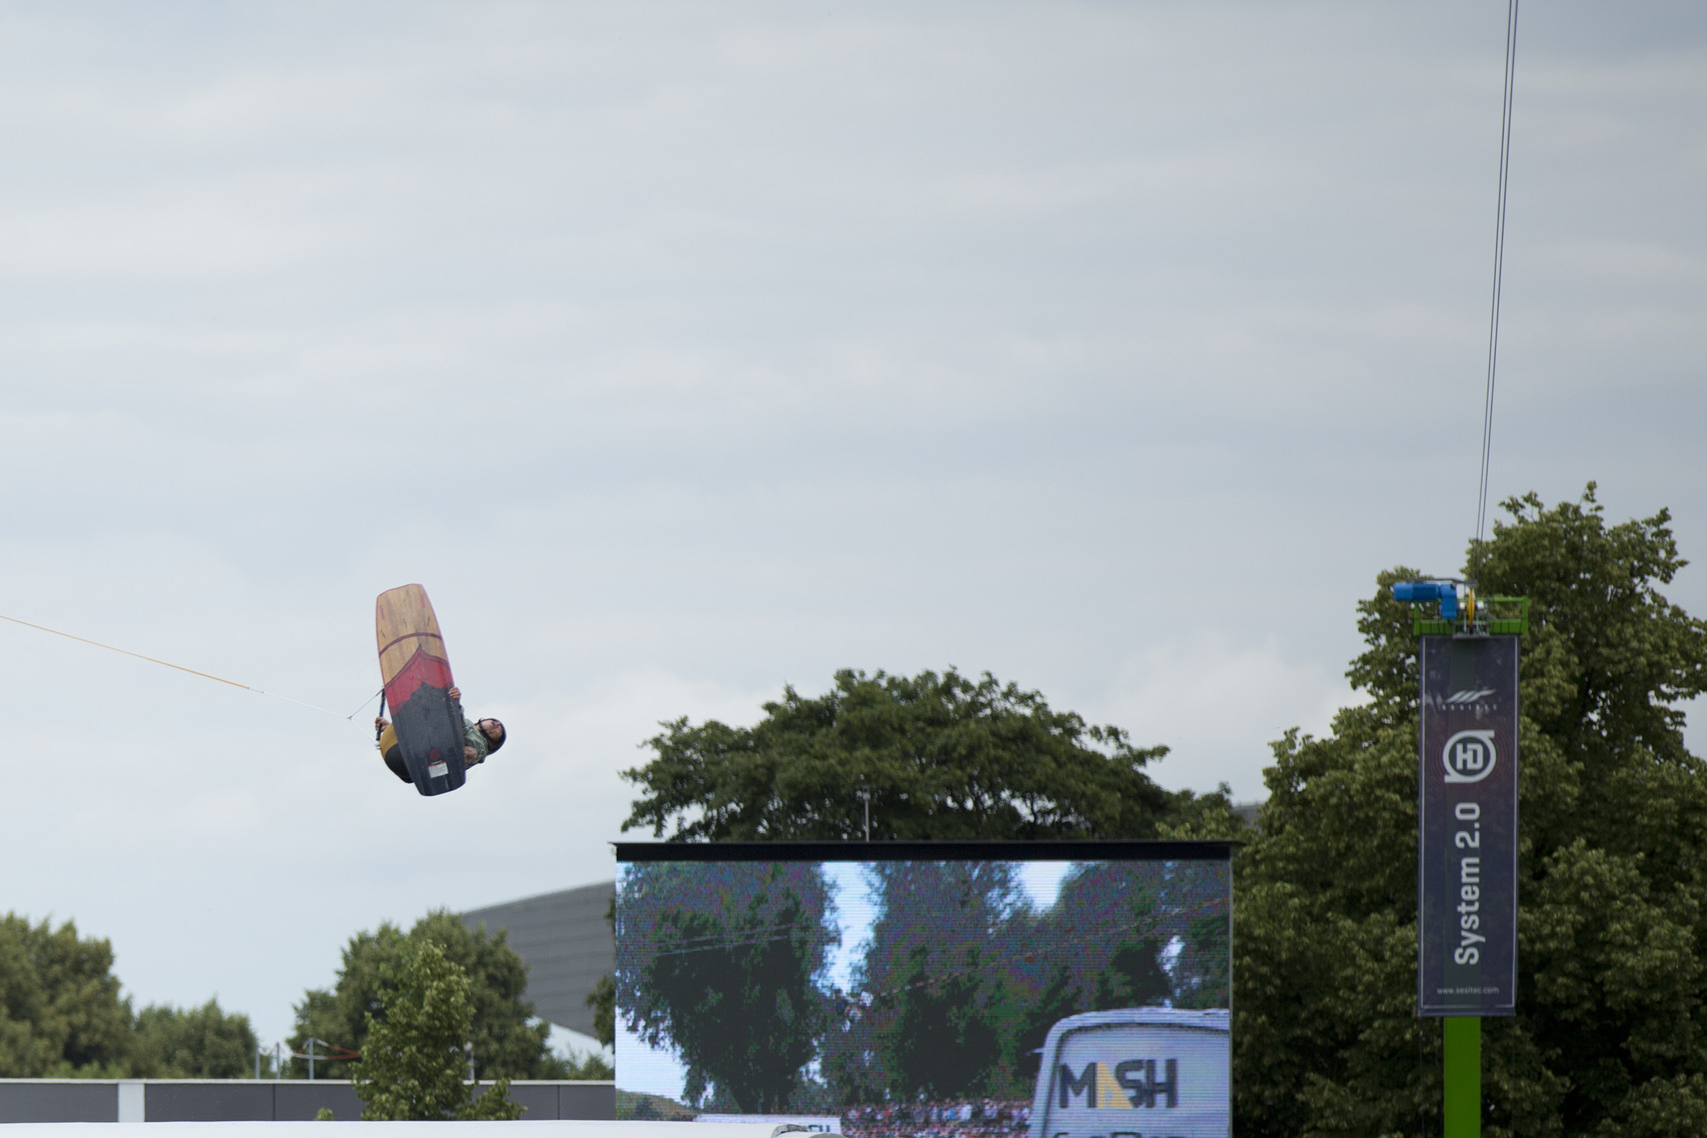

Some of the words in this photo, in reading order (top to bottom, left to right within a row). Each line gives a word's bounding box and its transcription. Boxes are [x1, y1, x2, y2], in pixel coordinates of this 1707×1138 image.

[1455, 802, 1481, 849] 2.0
[1454, 857, 1486, 966] System
[1059, 1059, 1178, 1109] MASH
